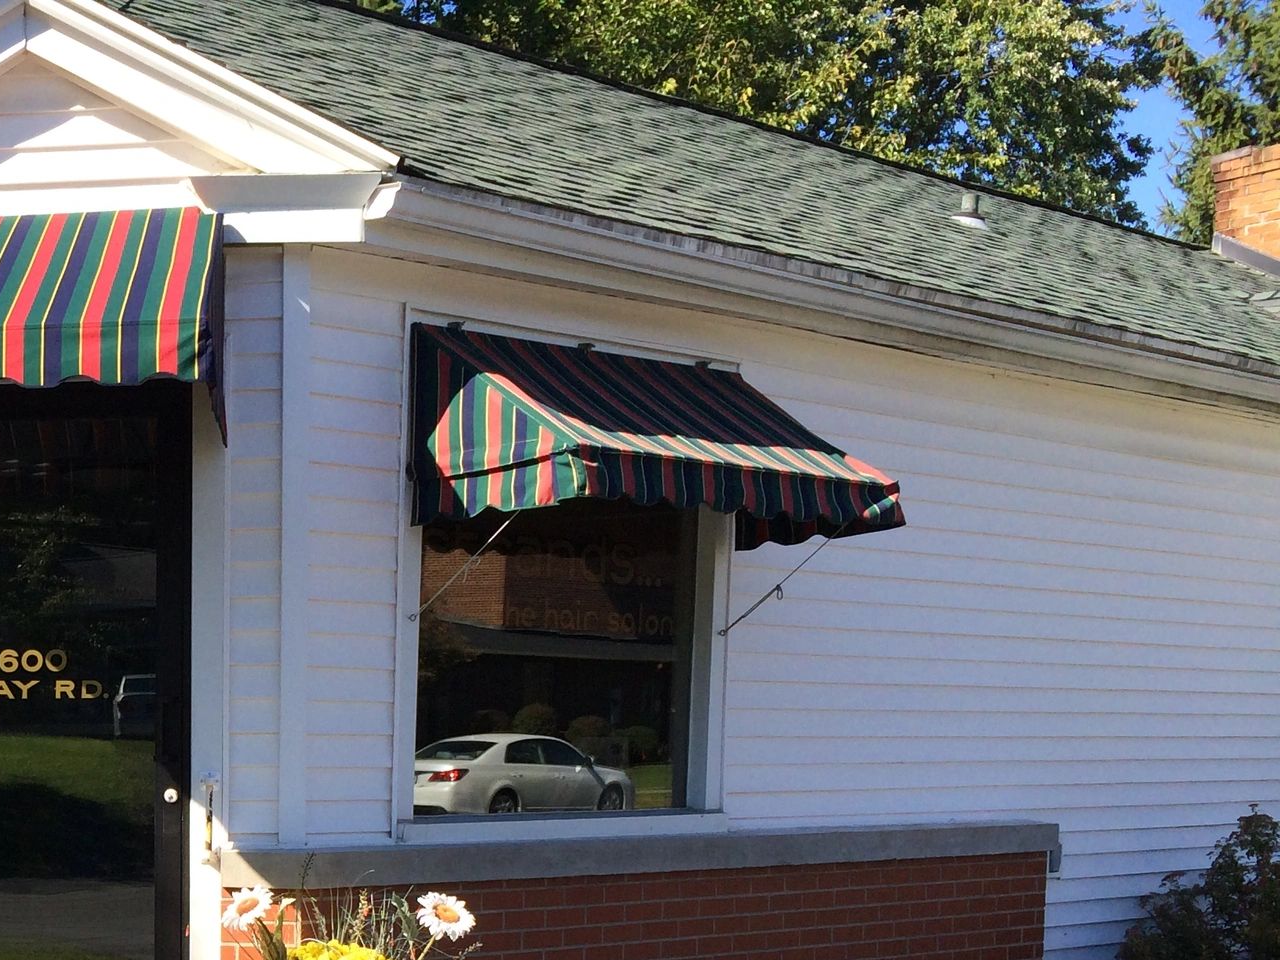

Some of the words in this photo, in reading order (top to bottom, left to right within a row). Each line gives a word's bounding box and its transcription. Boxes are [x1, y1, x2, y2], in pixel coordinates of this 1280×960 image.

[544, 597, 600, 632] hair
[607, 603, 674, 636] salon
[54, 681, 109, 700] RD.
